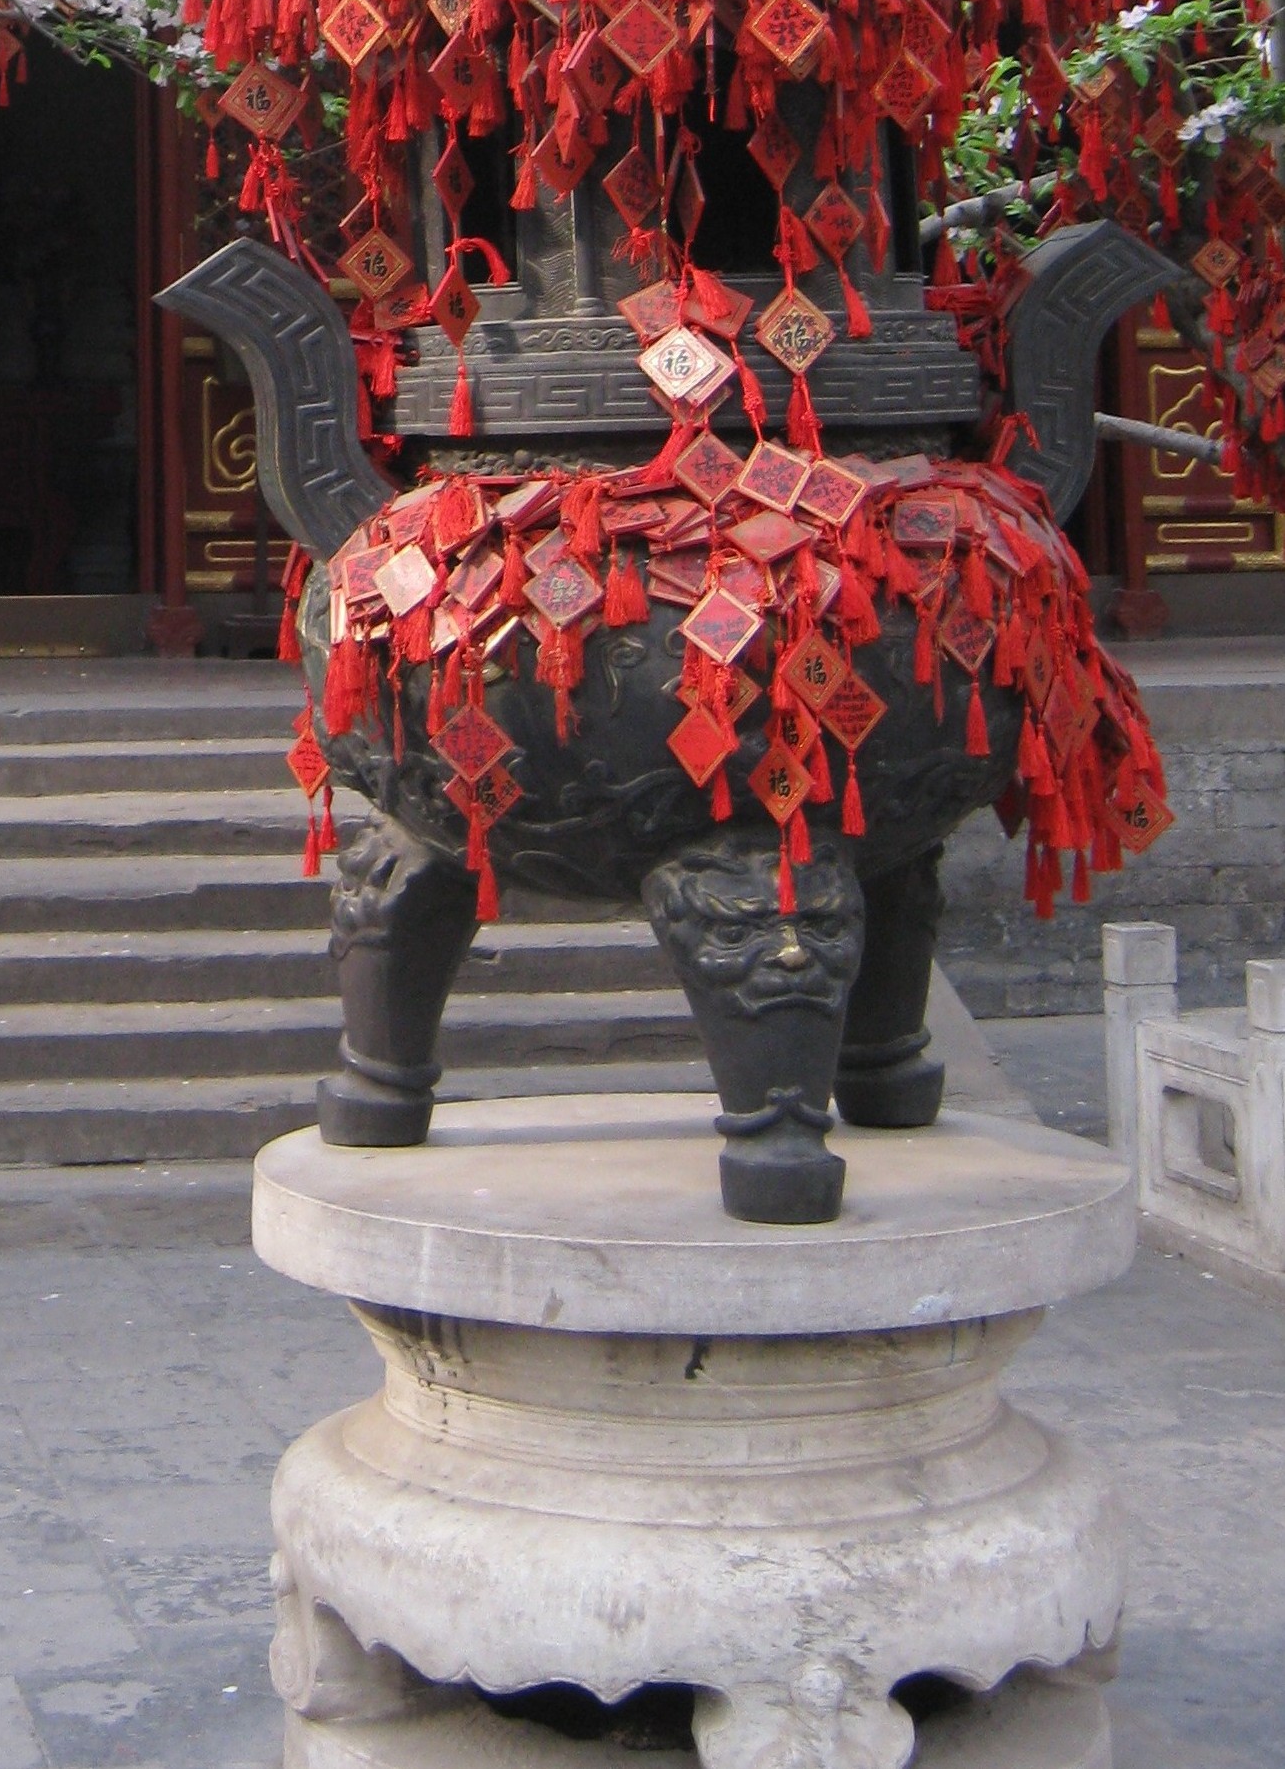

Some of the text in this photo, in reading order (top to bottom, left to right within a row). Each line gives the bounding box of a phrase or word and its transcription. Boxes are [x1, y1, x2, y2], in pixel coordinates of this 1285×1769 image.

[245, 84, 271, 112] 福
[362, 251, 388, 278] 福
[663, 345, 691, 376] 福
[805, 655, 827, 685] 福
[769, 767, 791, 798] 福
[1123, 801, 1149, 829] 福
